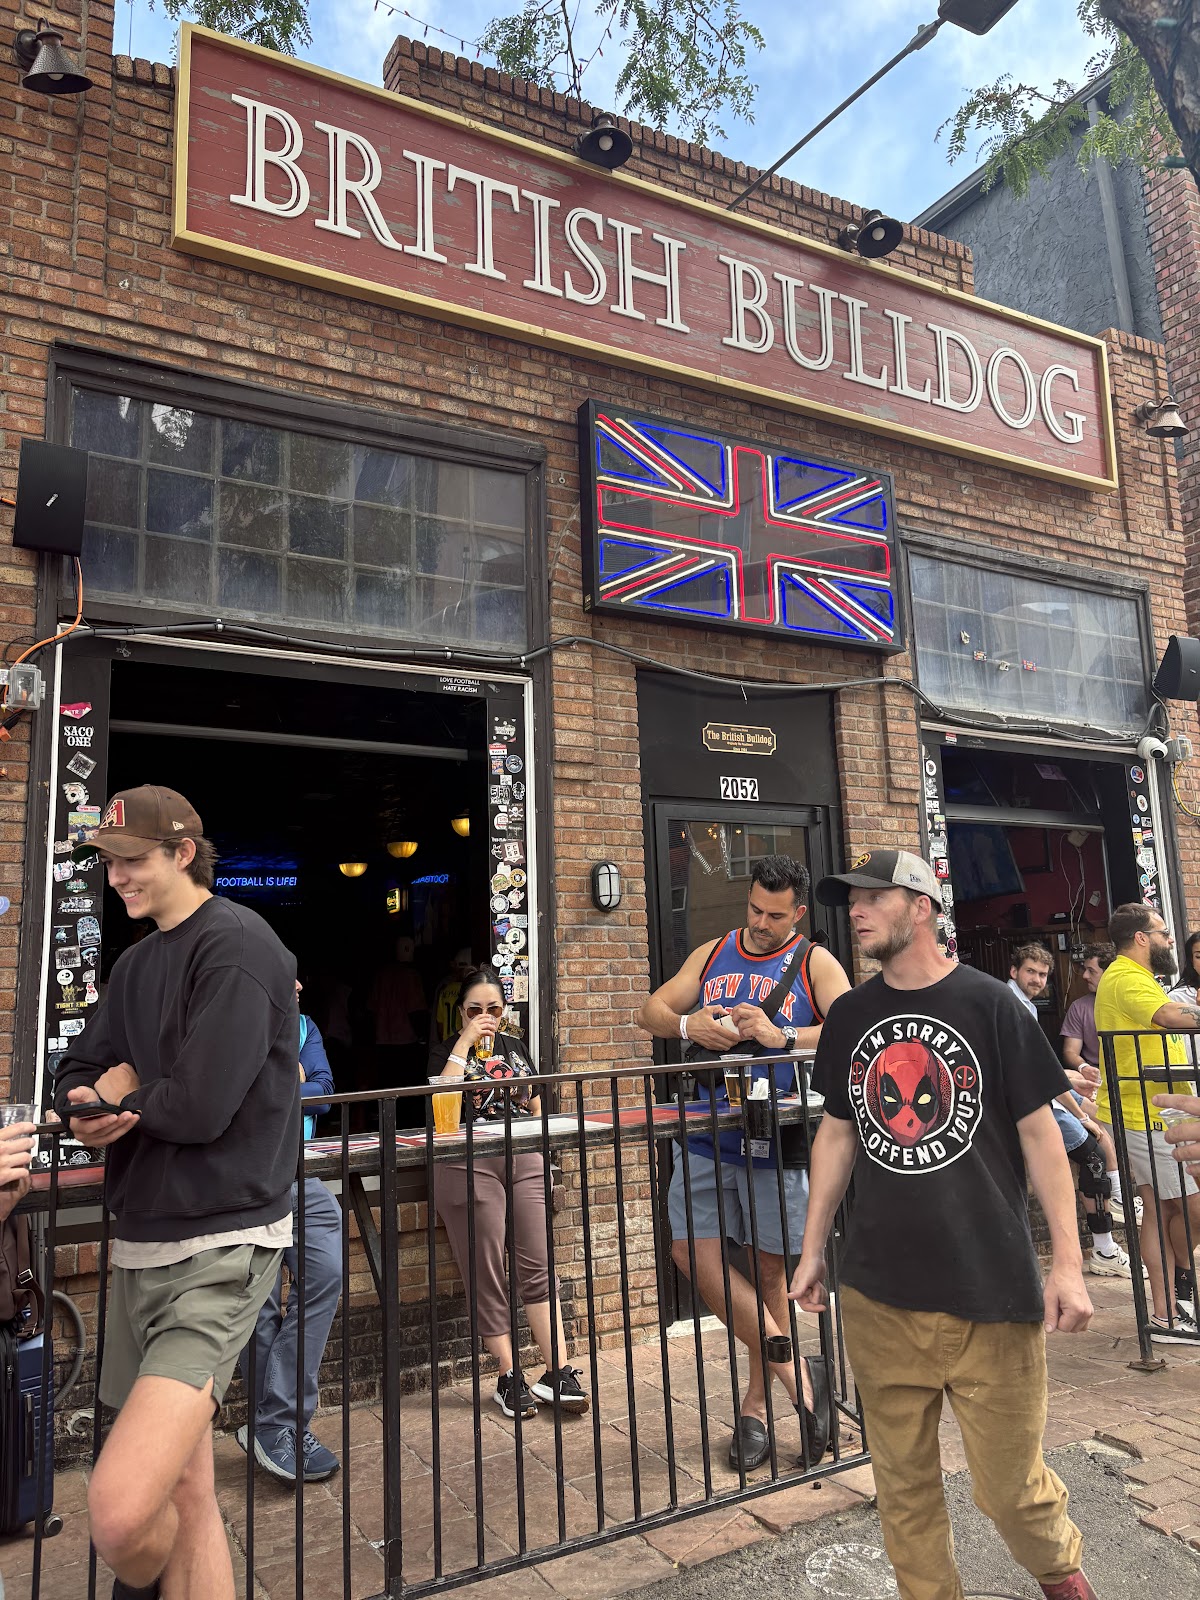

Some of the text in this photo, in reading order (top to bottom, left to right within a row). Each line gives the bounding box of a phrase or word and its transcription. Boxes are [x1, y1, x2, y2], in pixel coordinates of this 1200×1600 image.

[230, 93, 1087, 445] BRITISH BULLDOG
[64, 725, 95, 738] SACO
[707, 730, 719, 740] The
[721, 731, 744, 742] British
[746, 733, 772, 746] Bulldog
[66, 736, 92, 748] ONE
[722, 778, 757, 799] 2052
[216, 877, 297, 887] FOOTBALL IS LIFE!
[55, 1001, 89, 1010] TIGHT END
[703, 973, 797, 1023] NEW YOK
[859, 1021, 962, 1067] I'M SORRY,
[867, 1131, 947, 1167] OFFEND
[946, 1089, 978, 1145] YOU?
